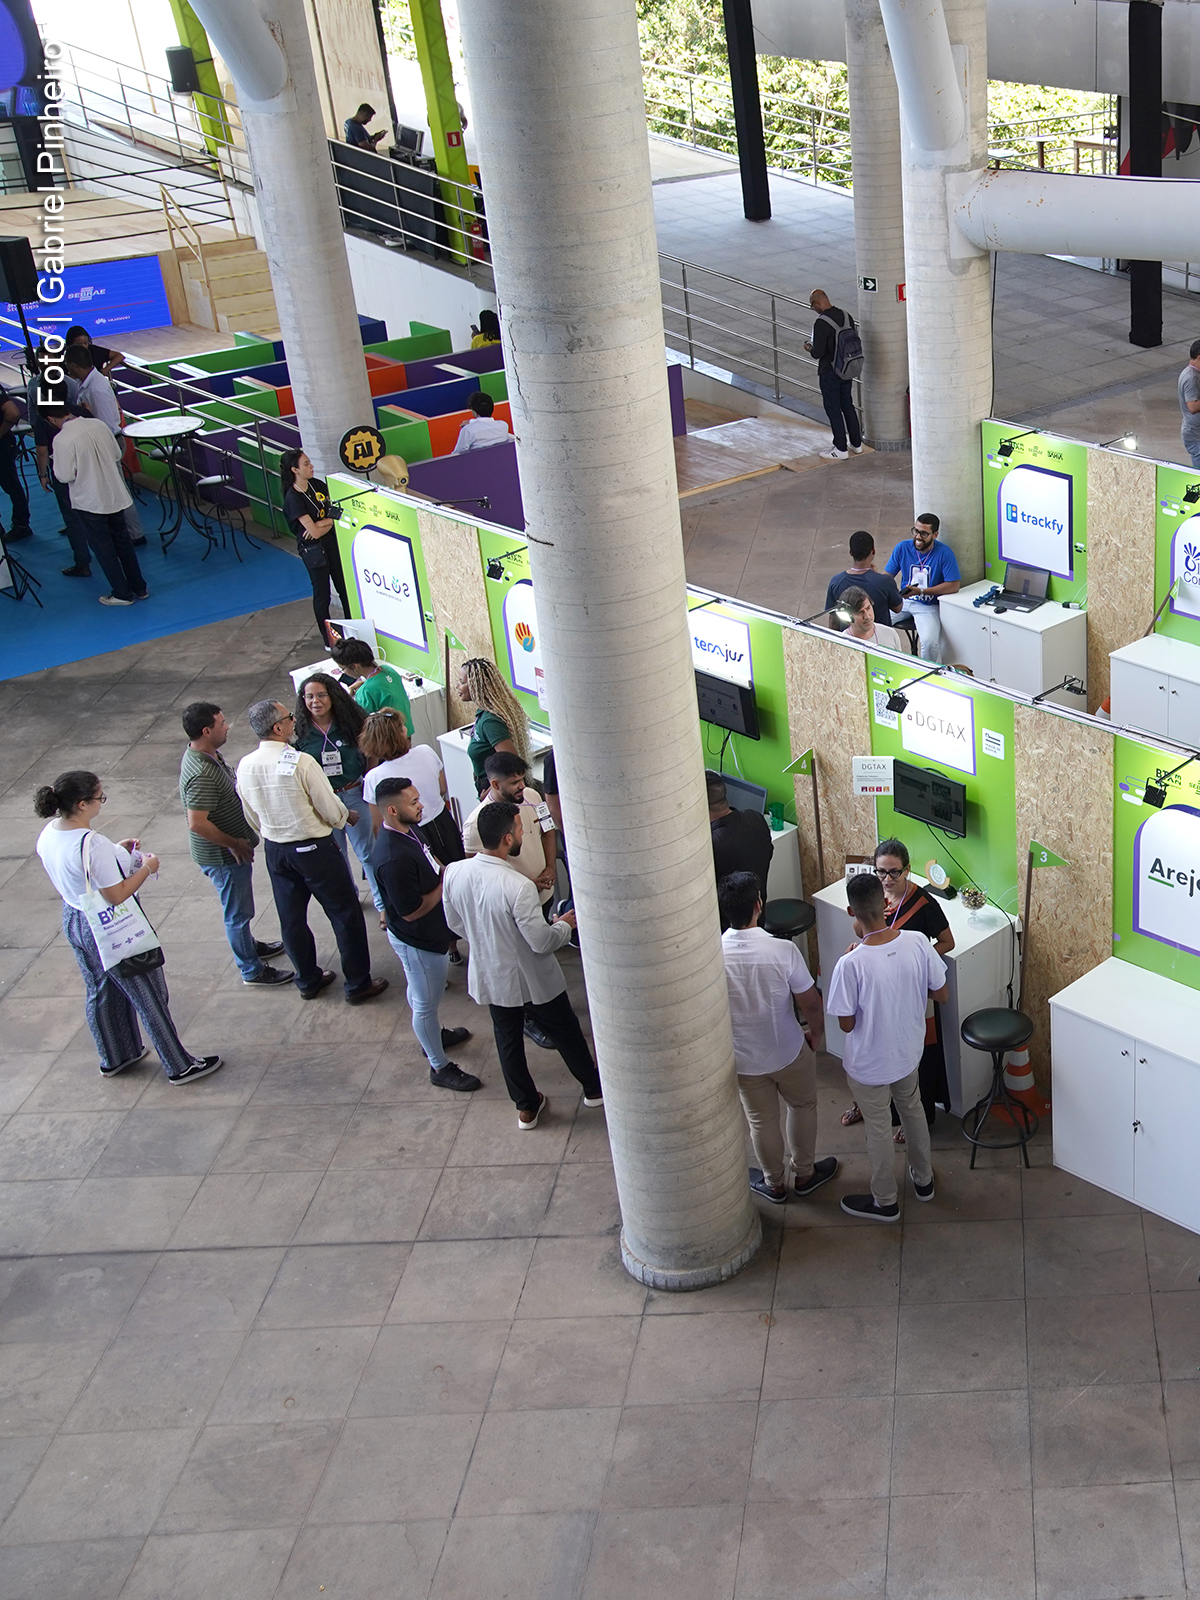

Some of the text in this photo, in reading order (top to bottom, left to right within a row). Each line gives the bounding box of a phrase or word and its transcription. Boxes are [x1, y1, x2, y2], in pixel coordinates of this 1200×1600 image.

[1020, 511, 1064, 535] trackfy
[915, 710, 967, 743] DGTAX
[800, 759, 808, 770] 4
[861, 763, 887, 771] DGTAX
[1039, 851, 1048, 863] 3
